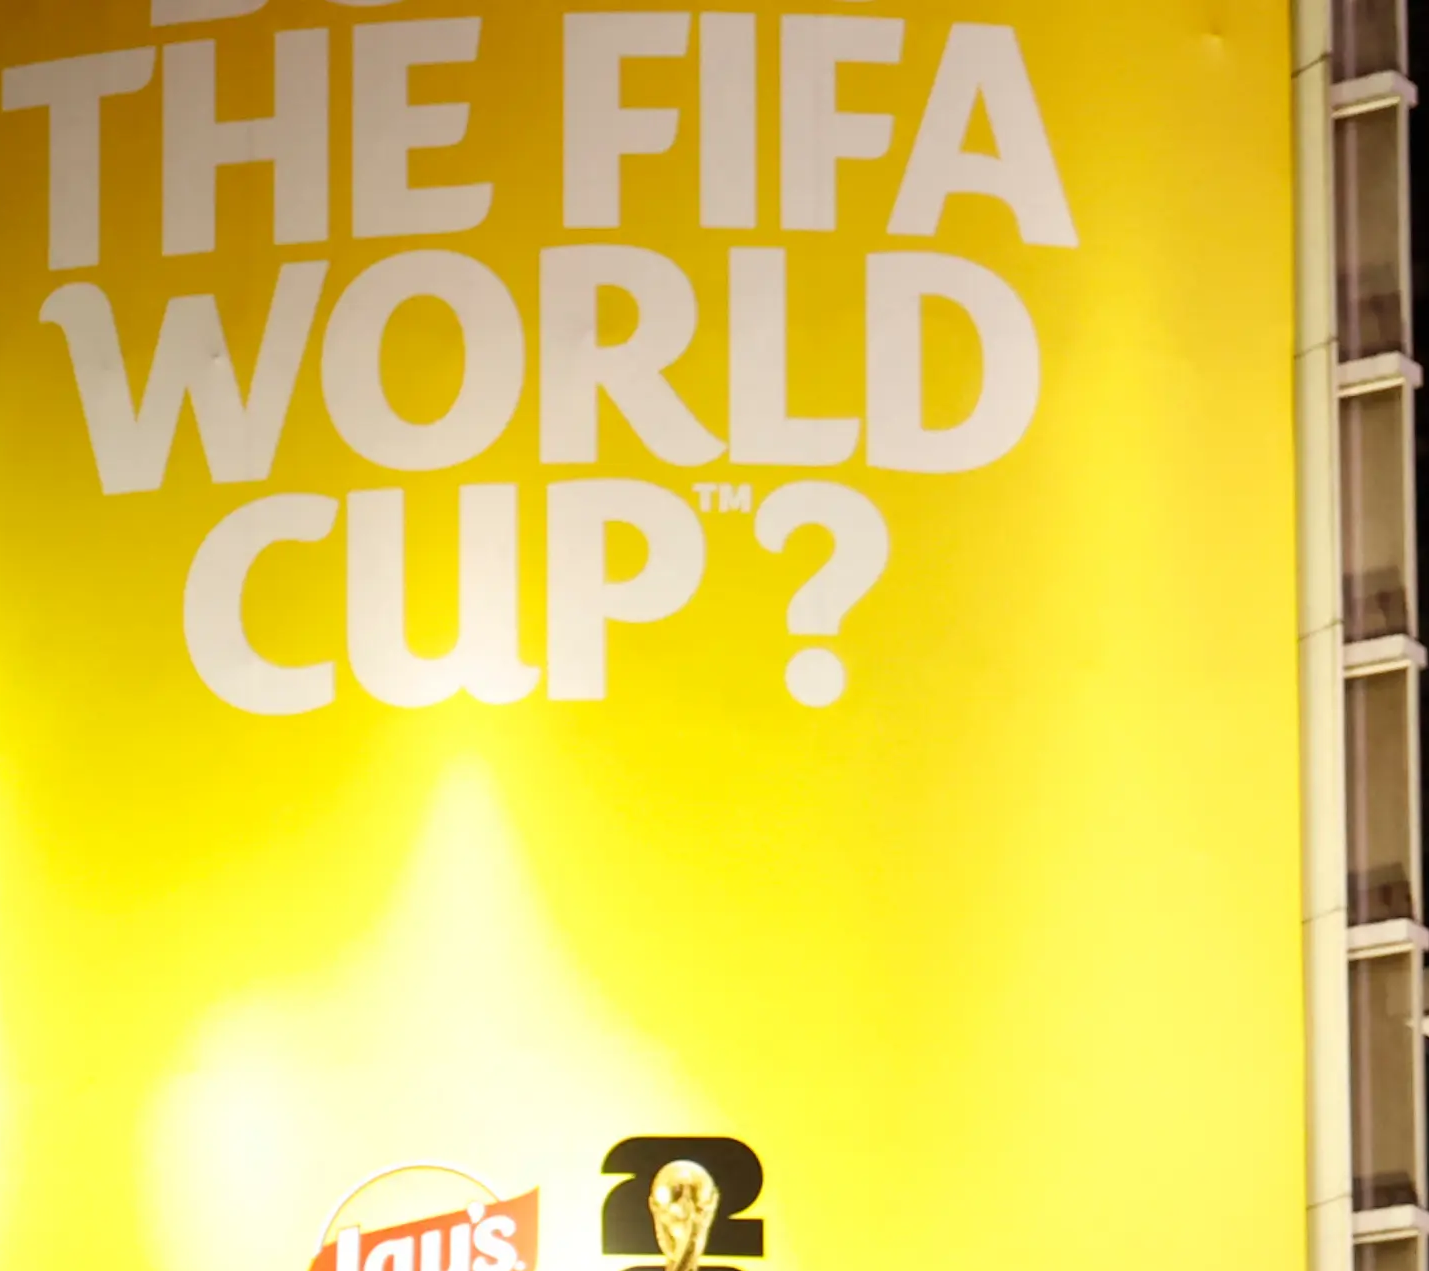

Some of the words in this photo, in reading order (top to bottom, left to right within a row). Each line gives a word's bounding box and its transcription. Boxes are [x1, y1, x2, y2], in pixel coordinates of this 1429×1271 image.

[1, 17, 493, 270] THE
[562, 12, 1078, 249] FIFA
[39, 245, 1042, 495] WORLD
